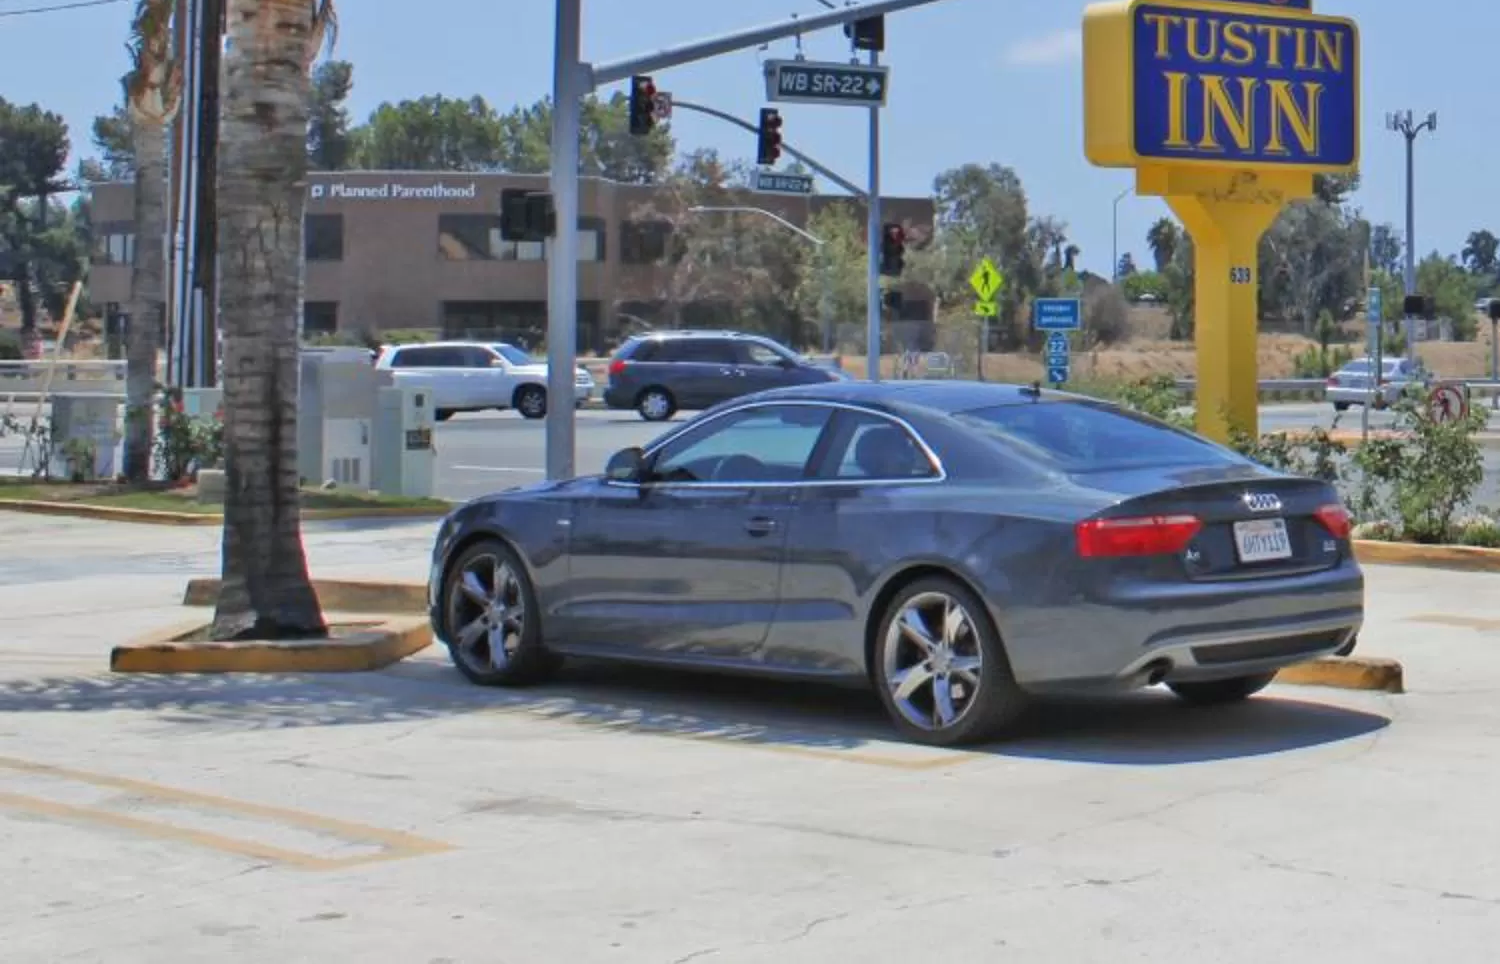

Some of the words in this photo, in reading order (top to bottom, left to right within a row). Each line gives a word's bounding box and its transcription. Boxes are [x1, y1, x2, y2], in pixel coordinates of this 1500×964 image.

[1143, 13, 1345, 72] TUSTIN
[780, 71, 808, 92] WB
[1162, 71, 1326, 158] INN
[331, 183, 388, 198] Planned
[392, 183, 475, 198] Parenthood
